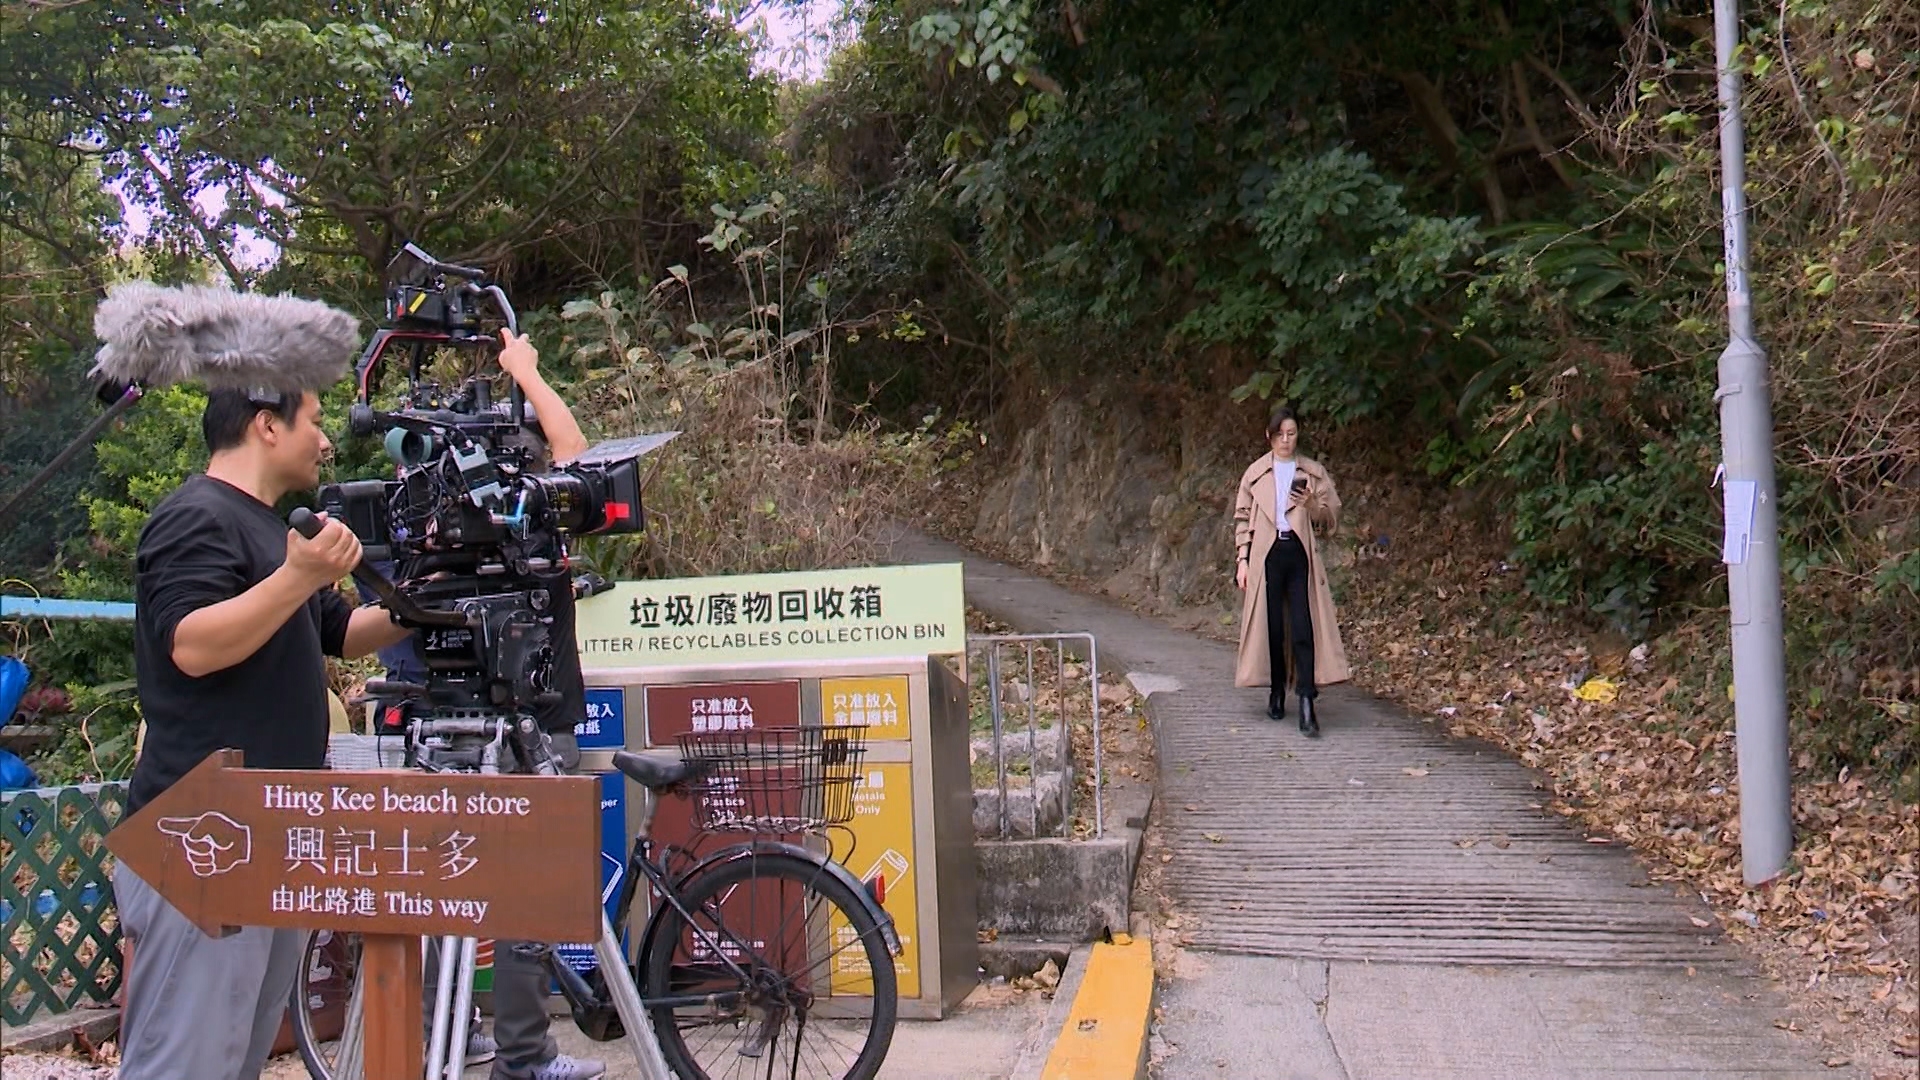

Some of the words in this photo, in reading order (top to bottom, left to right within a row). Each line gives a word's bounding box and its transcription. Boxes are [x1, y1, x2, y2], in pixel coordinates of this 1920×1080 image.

[629, 584, 882, 628] 垃圾/廢物回收箱
[577, 637, 633, 654] ITTER
[648, 631, 782, 650] RECYCLABLES
[787, 625, 908, 645] COLLECTION
[914, 623, 946, 639] BIN
[263, 784, 325, 816] Hing
[330, 786, 375, 811] Kee
[382, 786, 458, 814] beach
[466, 791, 531, 816] store
[855, 804, 882, 817] Only
[284, 825, 480, 881] 興記士多
[272, 884, 378, 917] 由此路進
[384, 890, 433, 916] This
[439, 898, 489, 924] way
